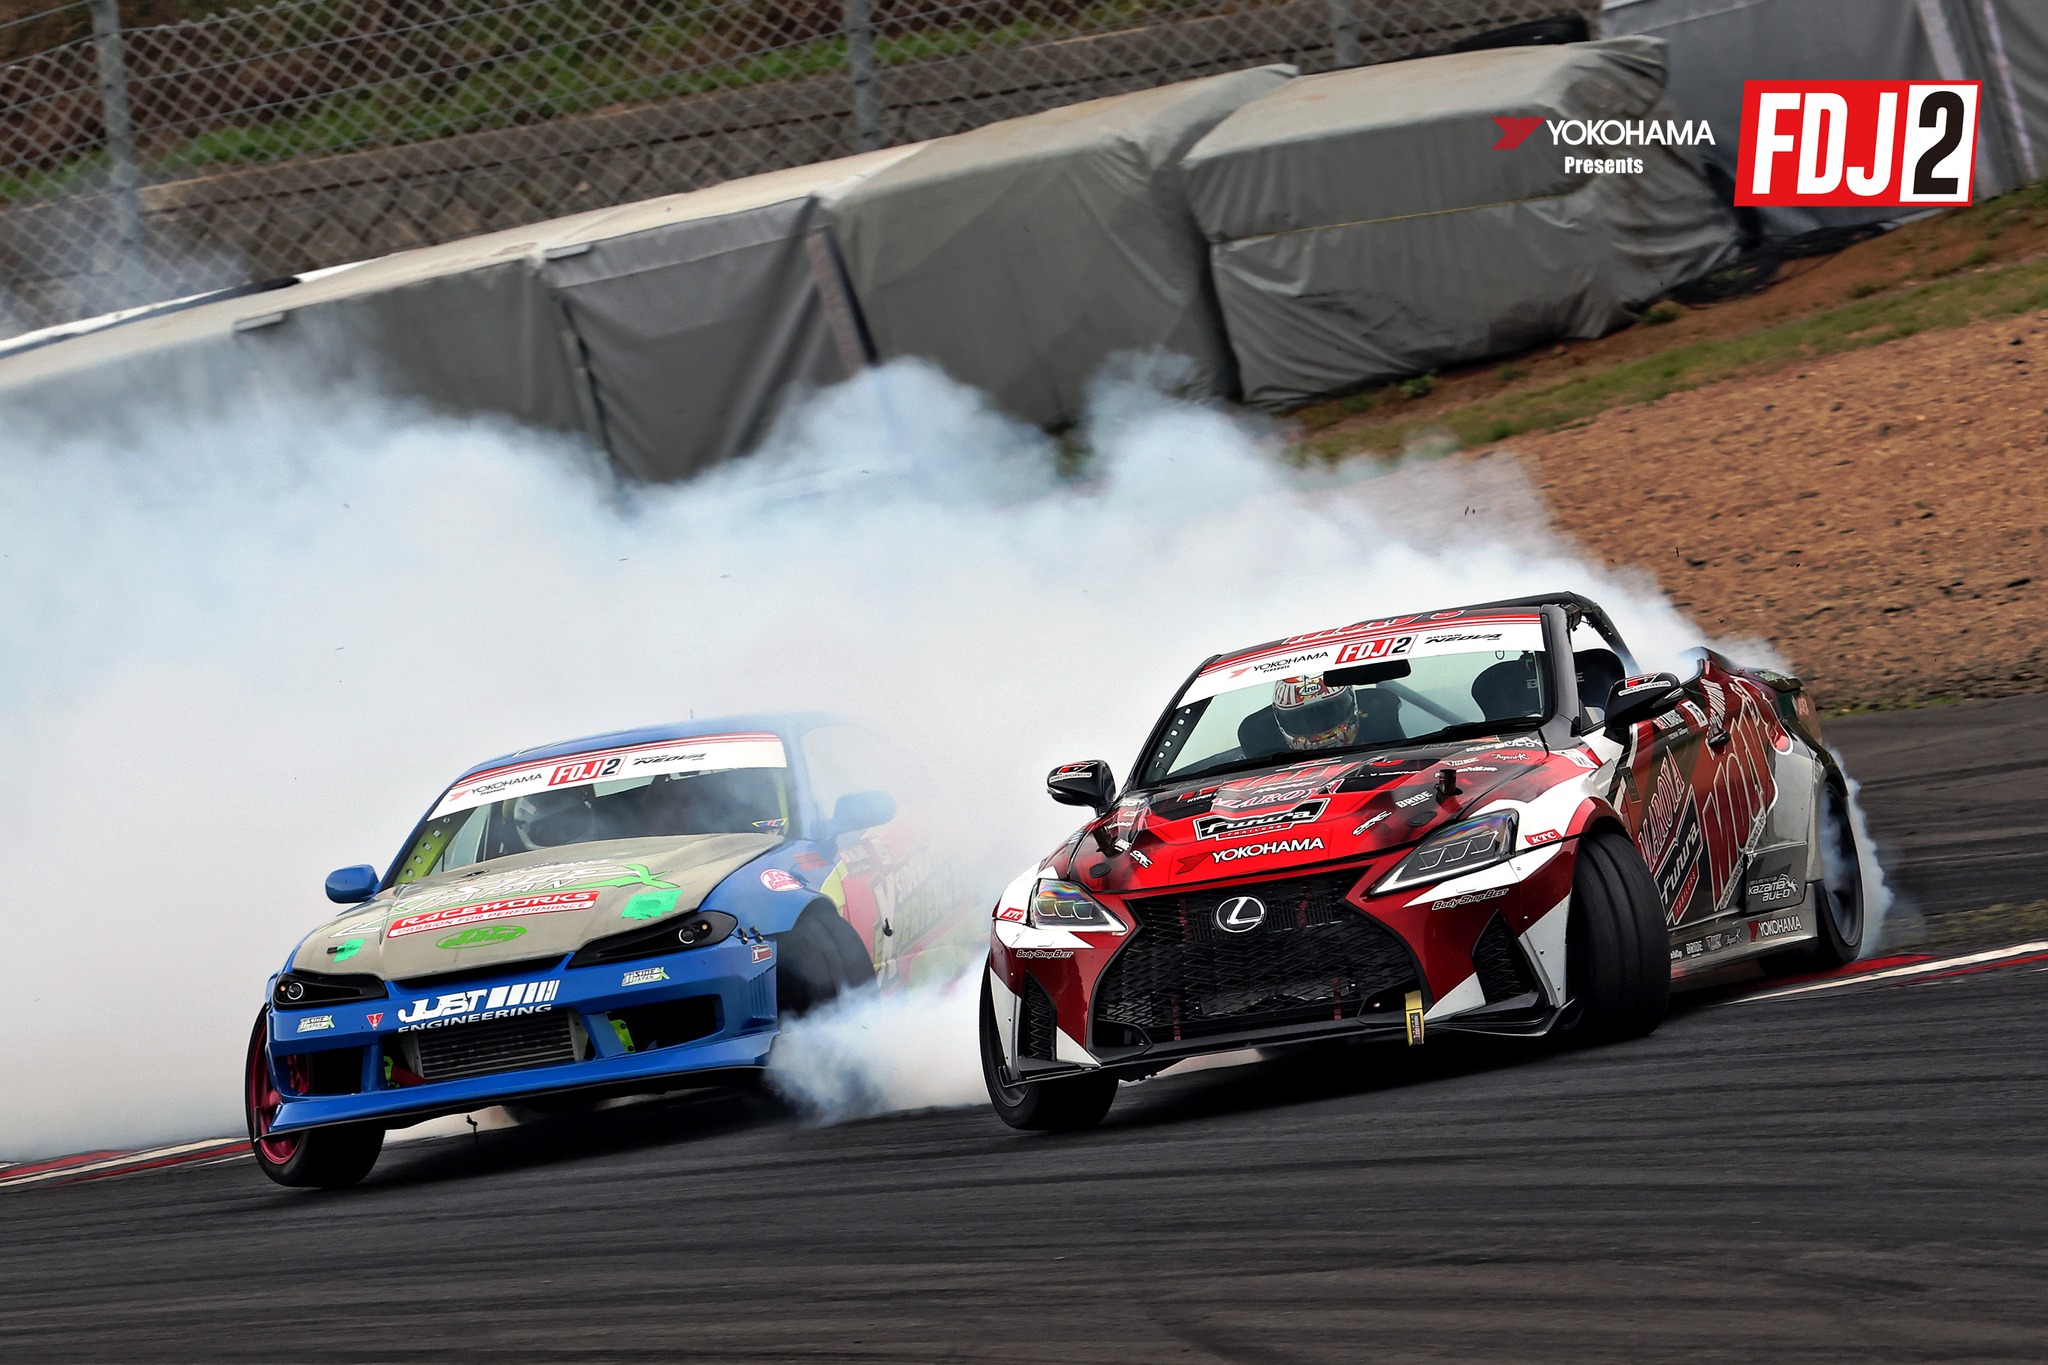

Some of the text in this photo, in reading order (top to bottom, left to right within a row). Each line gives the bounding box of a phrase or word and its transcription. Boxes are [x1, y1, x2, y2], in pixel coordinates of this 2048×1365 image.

[1253, 651, 1329, 672] YOKOHAMA
[471, 773, 543, 795] YOKOHAMA
[1395, 790, 1434, 808] BRIDE
[1207, 810, 1317, 834] Futura
[1531, 831, 1557, 844] KTC
[1212, 837, 1325, 864] YOKOHAMA
[397, 903, 588, 934] PASSION FOR PERFORMANCE
[400, 892, 592, 927] RACEWORKS
[1759, 915, 1803, 937] YOKOHAMA
[397, 1003, 553, 1034] ENGINEERING
